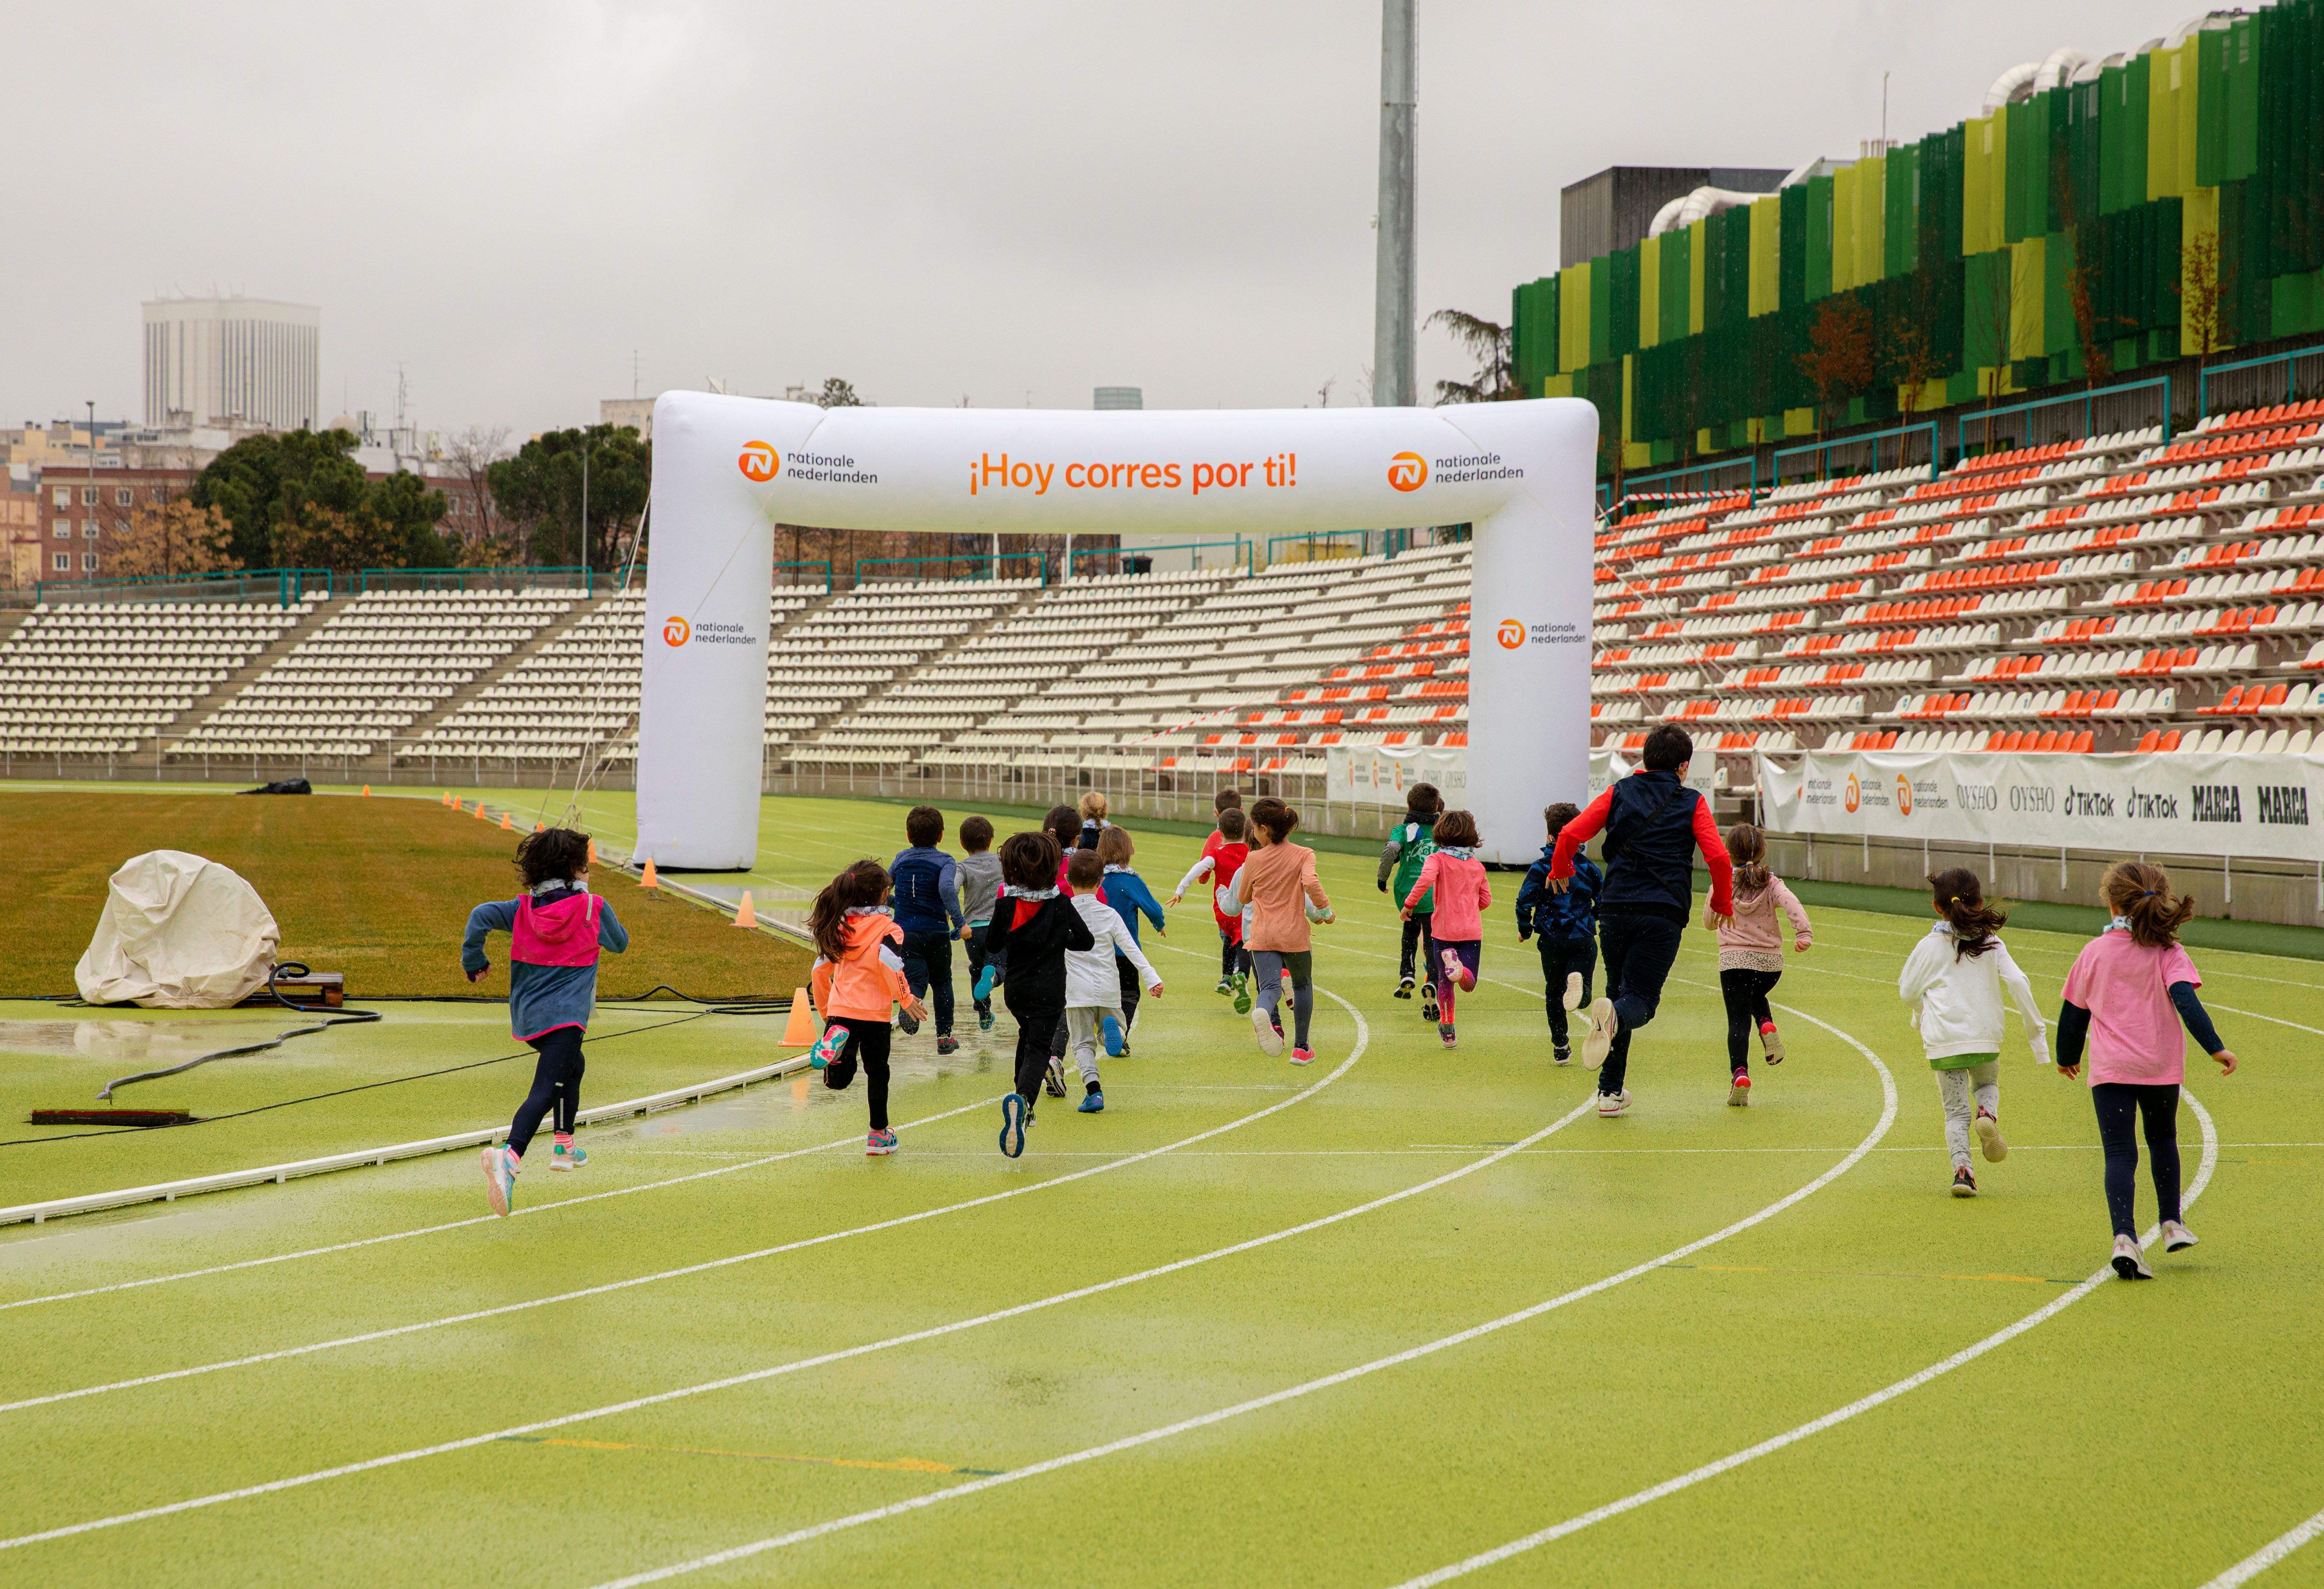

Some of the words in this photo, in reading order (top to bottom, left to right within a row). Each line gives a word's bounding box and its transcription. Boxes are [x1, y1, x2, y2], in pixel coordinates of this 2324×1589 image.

[788, 452, 854, 467] nationale
[1436, 452, 1501, 468] nationale
[788, 468, 878, 483] nederlanden
[969, 453, 1055, 495] ¡Hoy
[1065, 463, 1181, 488] corres
[1192, 463, 1253, 495] por
[1263, 453, 1296, 487] ti!
[1436, 466, 1524, 484] nederlanden
[696, 622, 744, 633] nationale
[1532, 622, 1576, 632] nationale
[696, 634, 756, 645] nederlanden
[1532, 634, 1586, 643] nederlanden
[1957, 785, 1997, 811] OYSHO
[2010, 785, 2055, 813] OYSHO
[2077, 792, 2115, 817] TikTok
[2138, 793, 2178, 819] TikTok
[2191, 785, 2242, 823] MARCA
[2257, 786, 2309, 825] MARCA
